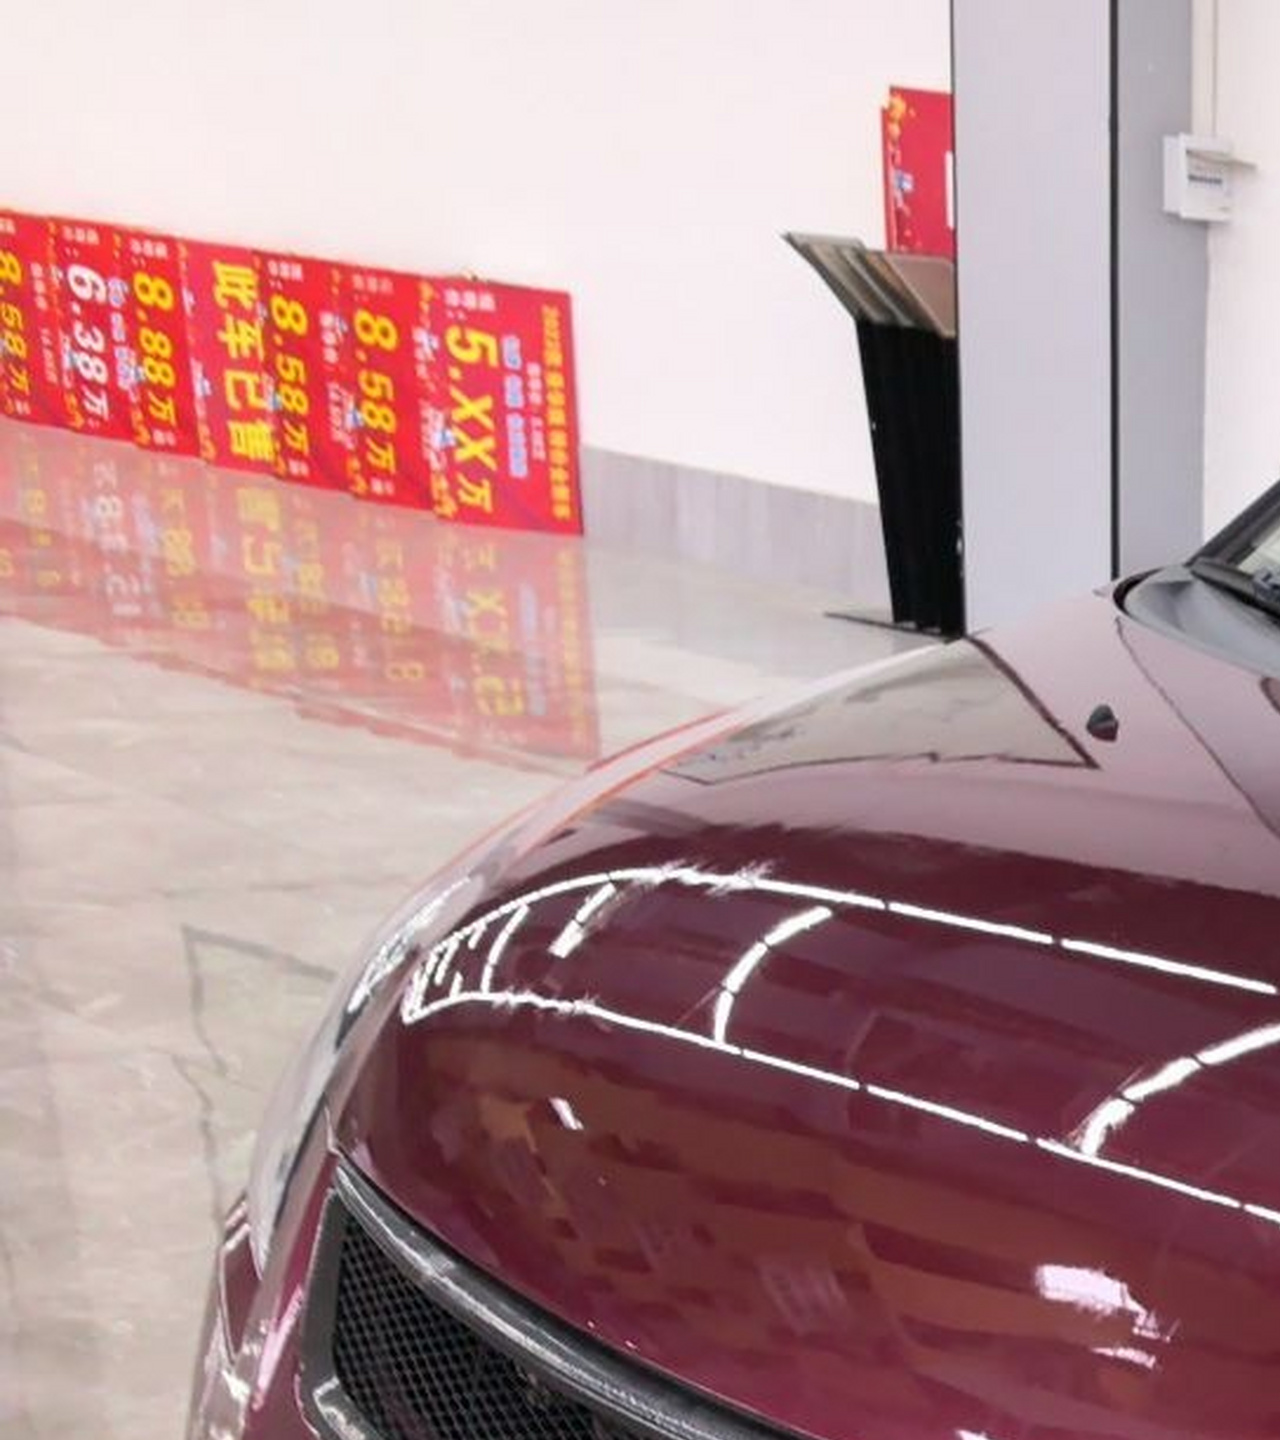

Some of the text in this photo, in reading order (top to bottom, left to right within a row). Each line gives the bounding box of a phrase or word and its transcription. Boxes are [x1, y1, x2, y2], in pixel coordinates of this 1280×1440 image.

[67, 264, 109, 420] 6.38万
[133, 271, 178, 430] 8.88万
[212, 260, 277, 464] 此车已售
[270, 293, 311, 457] 8.58万
[353, 308, 400, 475] 8.58万
[445, 324, 499, 514] 5.XX万
